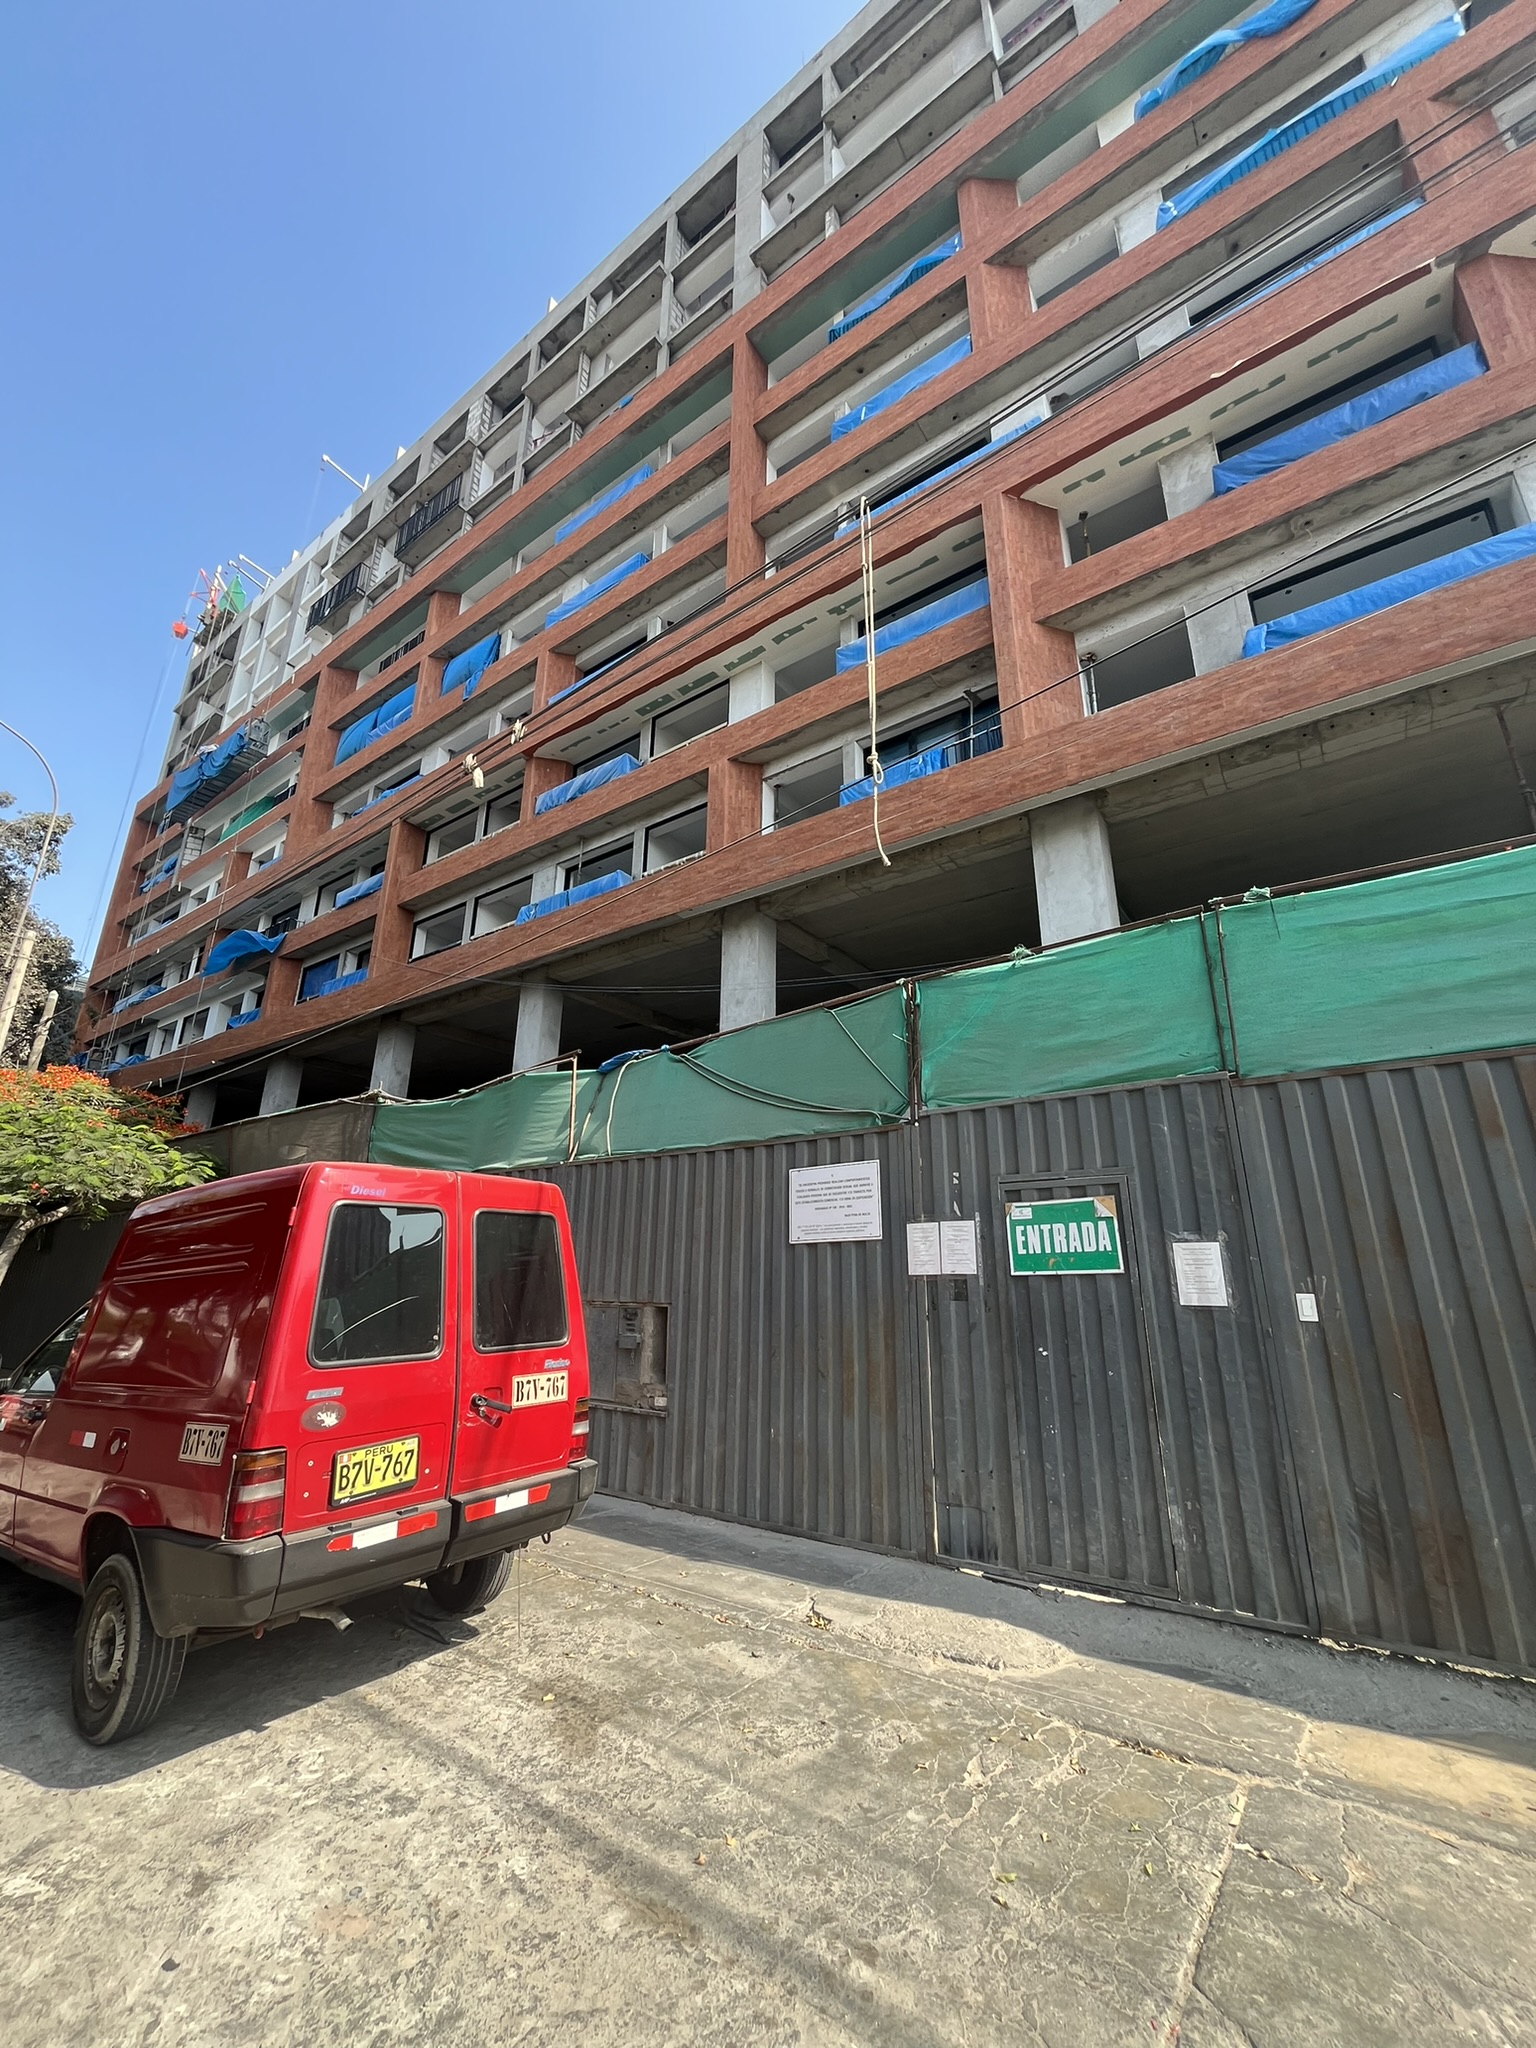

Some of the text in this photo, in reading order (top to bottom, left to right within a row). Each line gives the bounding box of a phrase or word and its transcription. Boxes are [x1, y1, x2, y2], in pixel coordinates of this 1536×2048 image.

[350, 1184, 387, 1197] Diesel
[1015, 1220, 1112, 1255] ENTRADA
[515, 1375, 566, 1403] B7V-767
[364, 1444, 394, 1459] PERU
[338, 1448, 415, 1492] B7V-767
